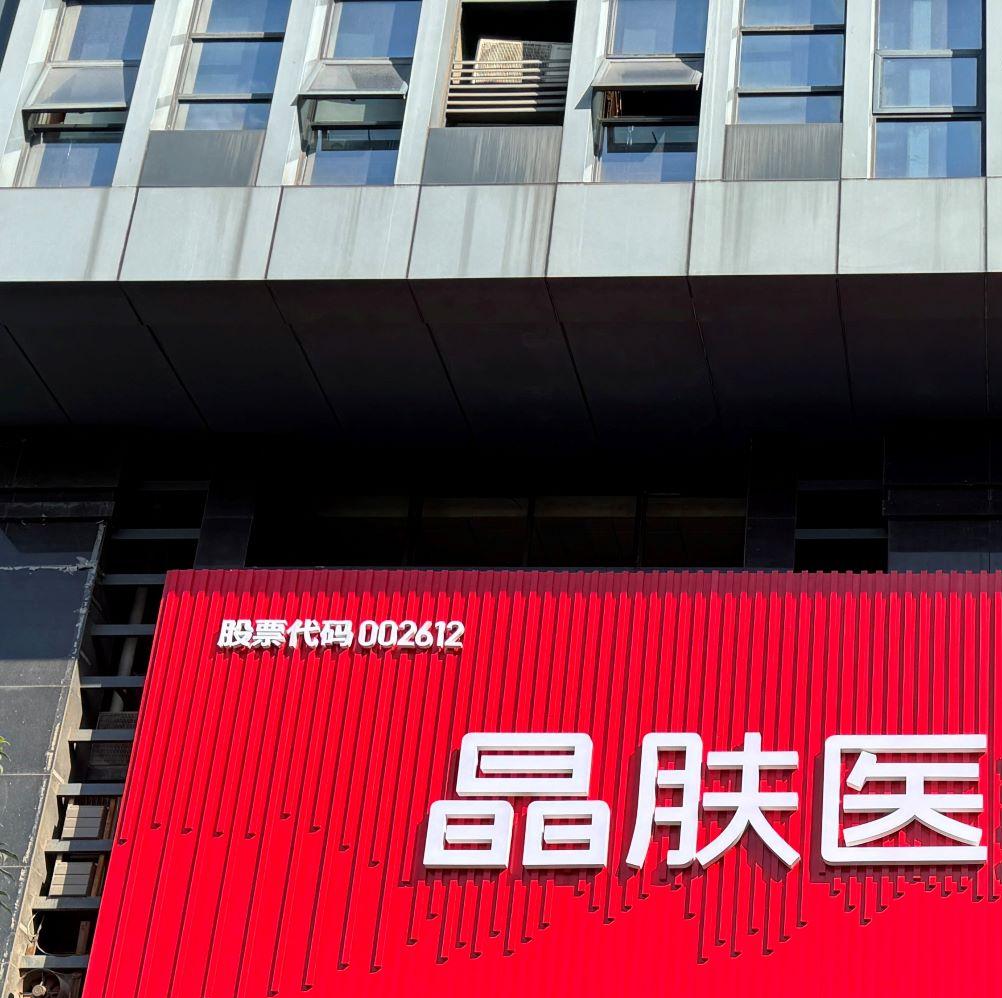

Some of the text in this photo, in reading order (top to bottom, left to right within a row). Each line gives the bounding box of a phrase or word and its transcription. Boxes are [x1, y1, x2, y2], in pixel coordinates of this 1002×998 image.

[217, 619, 464, 648] 股票代码 002612
